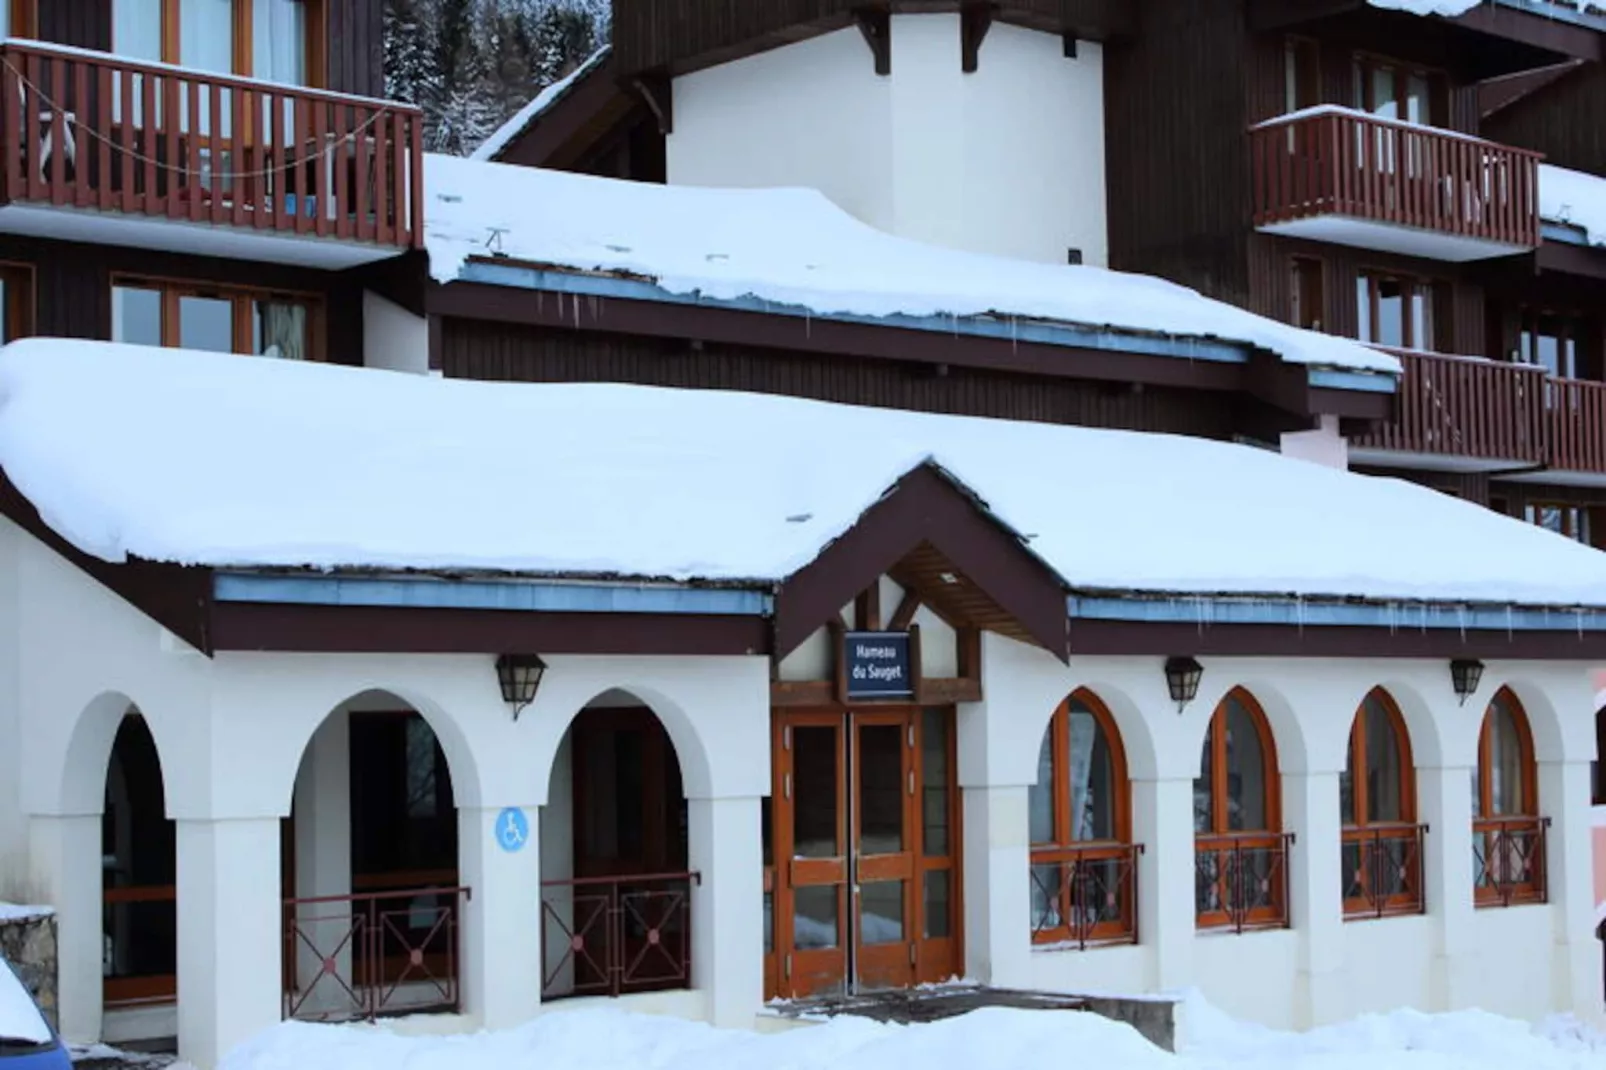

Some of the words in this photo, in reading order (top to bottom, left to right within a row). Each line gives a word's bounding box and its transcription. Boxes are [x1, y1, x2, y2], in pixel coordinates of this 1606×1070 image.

[856, 644, 896, 659] Hameau
[852, 664, 867, 679] du
[868, 663, 902, 681] Sauget
